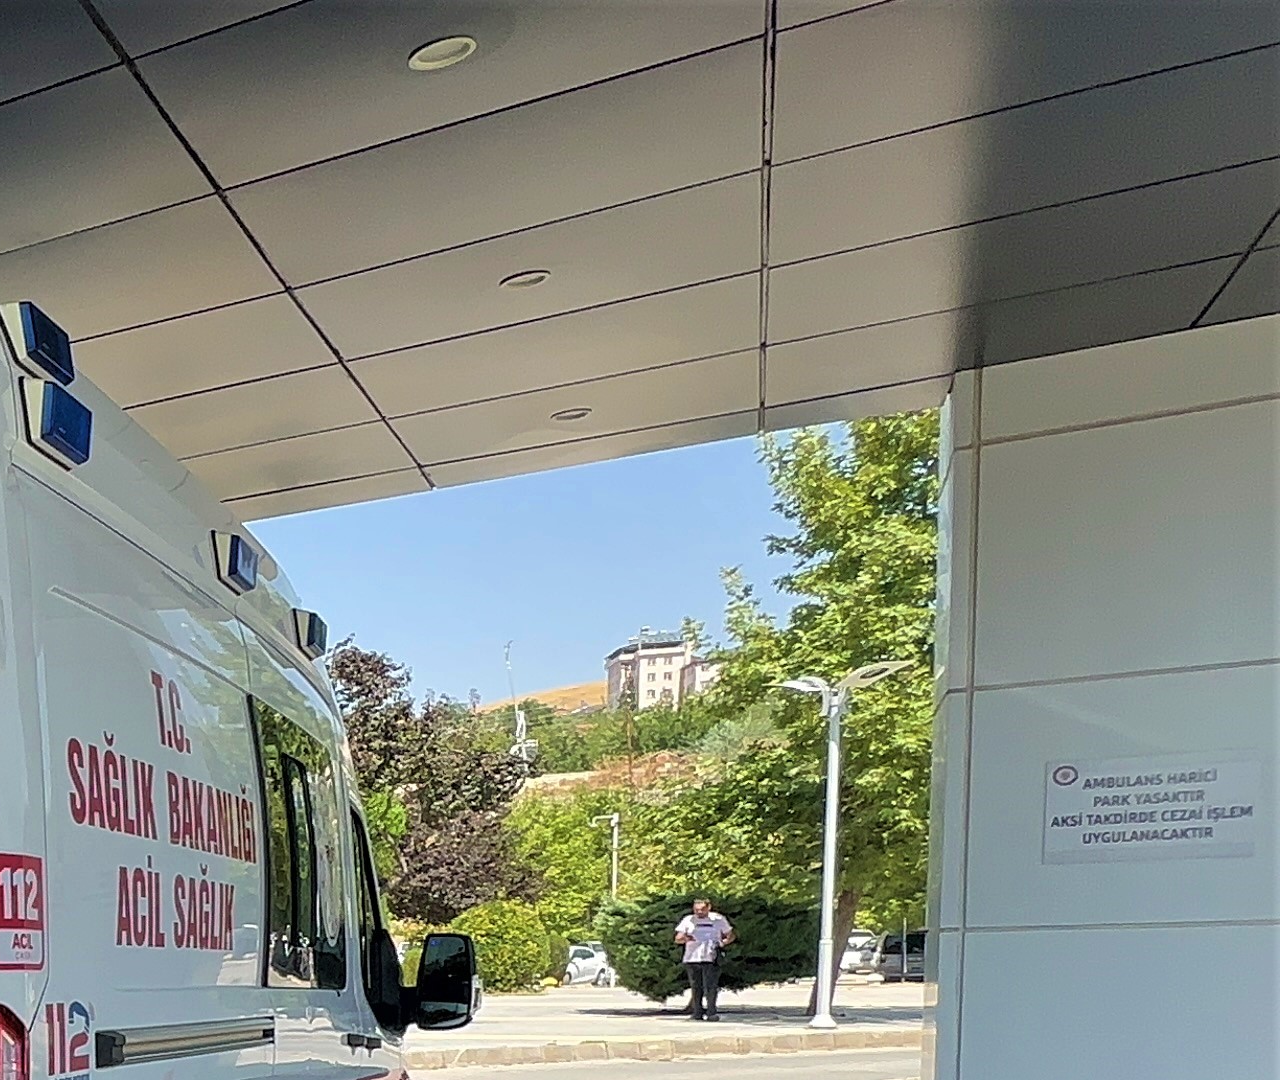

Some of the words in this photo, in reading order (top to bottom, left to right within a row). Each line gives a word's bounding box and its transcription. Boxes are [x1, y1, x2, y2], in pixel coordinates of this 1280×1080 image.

[150, 669, 191, 754] T.C.
[67, 730, 158, 841] SAĞLIK
[166, 770, 258, 865] BAKANLIĞI
[1082, 772, 1164, 790] AMBULANS
[1167, 768, 1218, 784] HARİCİ
[1093, 793, 1131, 808] PARK
[1134, 790, 1205, 805] YASAKTIR
[1050, 811, 1083, 828] AKSİ
[1086, 809, 1157, 826] TAKDİRDE
[1207, 805, 1253, 823] İŞLEM
[1082, 826, 1214, 844] UYGULANACAKTIR
[116, 855, 166, 948] ACİL
[173, 863, 235, 951] SAĞLIK
[45, 1001, 90, 1076] 112
